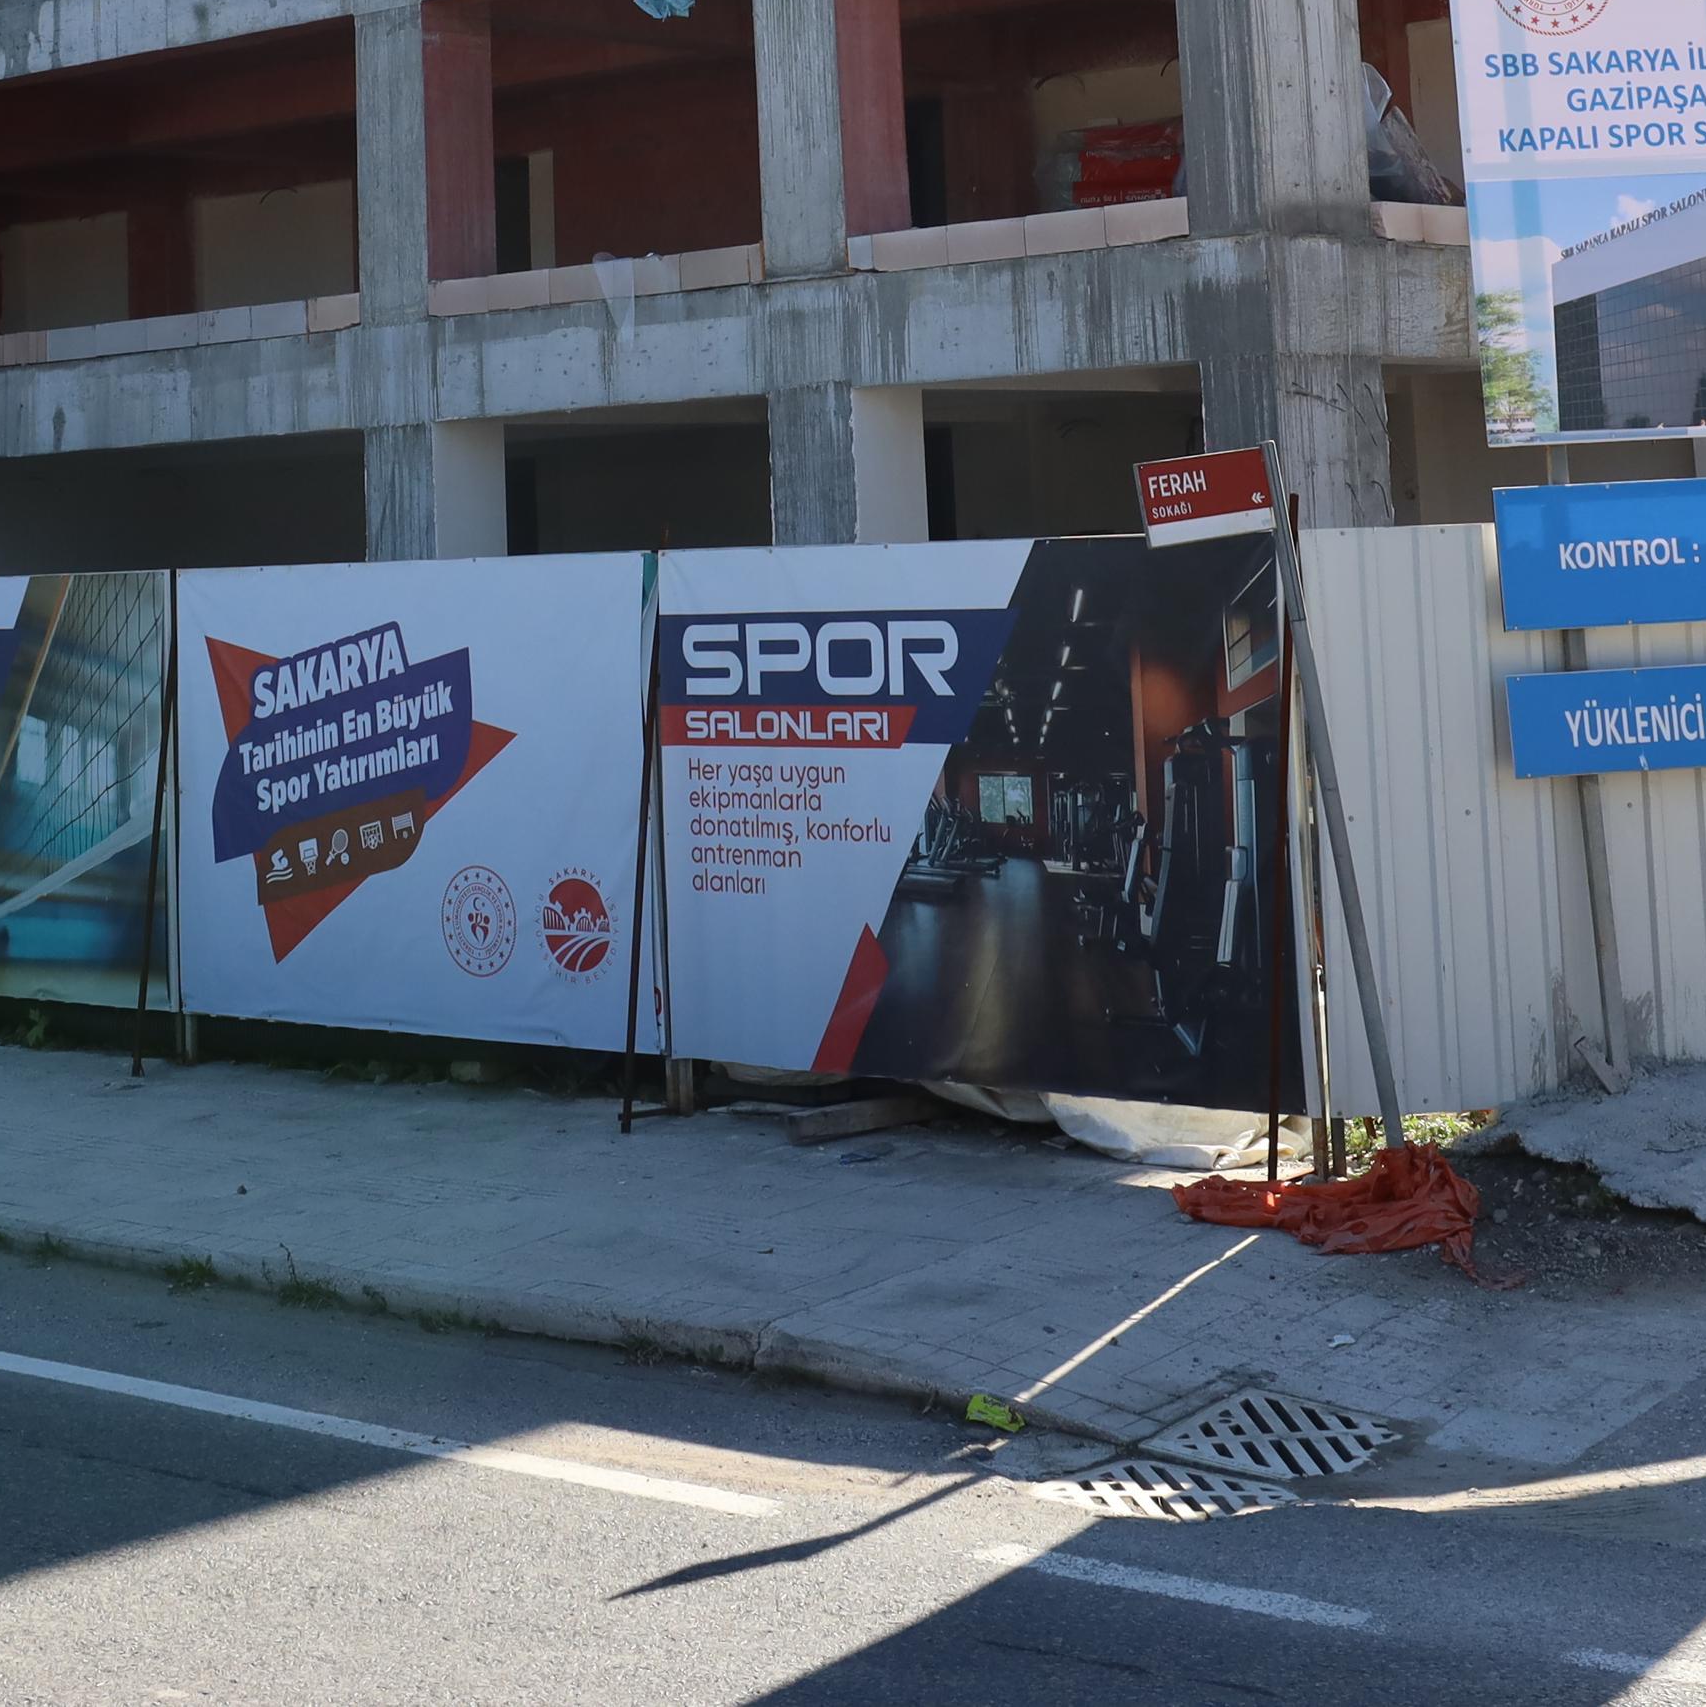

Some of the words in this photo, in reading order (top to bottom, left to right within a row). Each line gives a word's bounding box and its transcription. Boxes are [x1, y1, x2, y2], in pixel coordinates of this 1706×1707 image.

[1485, 51, 1540, 79] SBB
[1548, 45, 1681, 77] SAKARYA
[1499, 124, 1600, 154] KAPALI
[1608, 120, 1686, 149] SPOR
[1575, 232, 1609, 256] SAPANCA
[1610, 217, 1641, 241] KAPALI
[1641, 207, 1668, 227] SPOR
[1147, 469, 1207, 499] FERAH
[1151, 501, 1192, 519] SOKAĞI
[1558, 538, 1686, 571] KONTROL
[253, 628, 406, 720] SAKARYA
[681, 619, 960, 698] SPOR
[238, 722, 340, 777] Tarihinin
[342, 712, 373, 746] En
[375, 680, 454, 739] Büyük
[685, 709, 890, 742] SALONLARI
[256, 768, 311, 815] Spor
[313, 733, 440, 797] Yatırımları
[688, 757, 723, 782] Her
[727, 763, 773, 788] yaşa
[780, 764, 846, 790] uygun
[689, 785, 822, 814] ekipmanlarla
[690, 814, 800, 846] donatılmış,
[806, 816, 892, 843] konforlu
[691, 843, 802, 869] antrenman
[548, 866, 601, 890] SAKARYA
[692, 868, 766, 895] alanları
